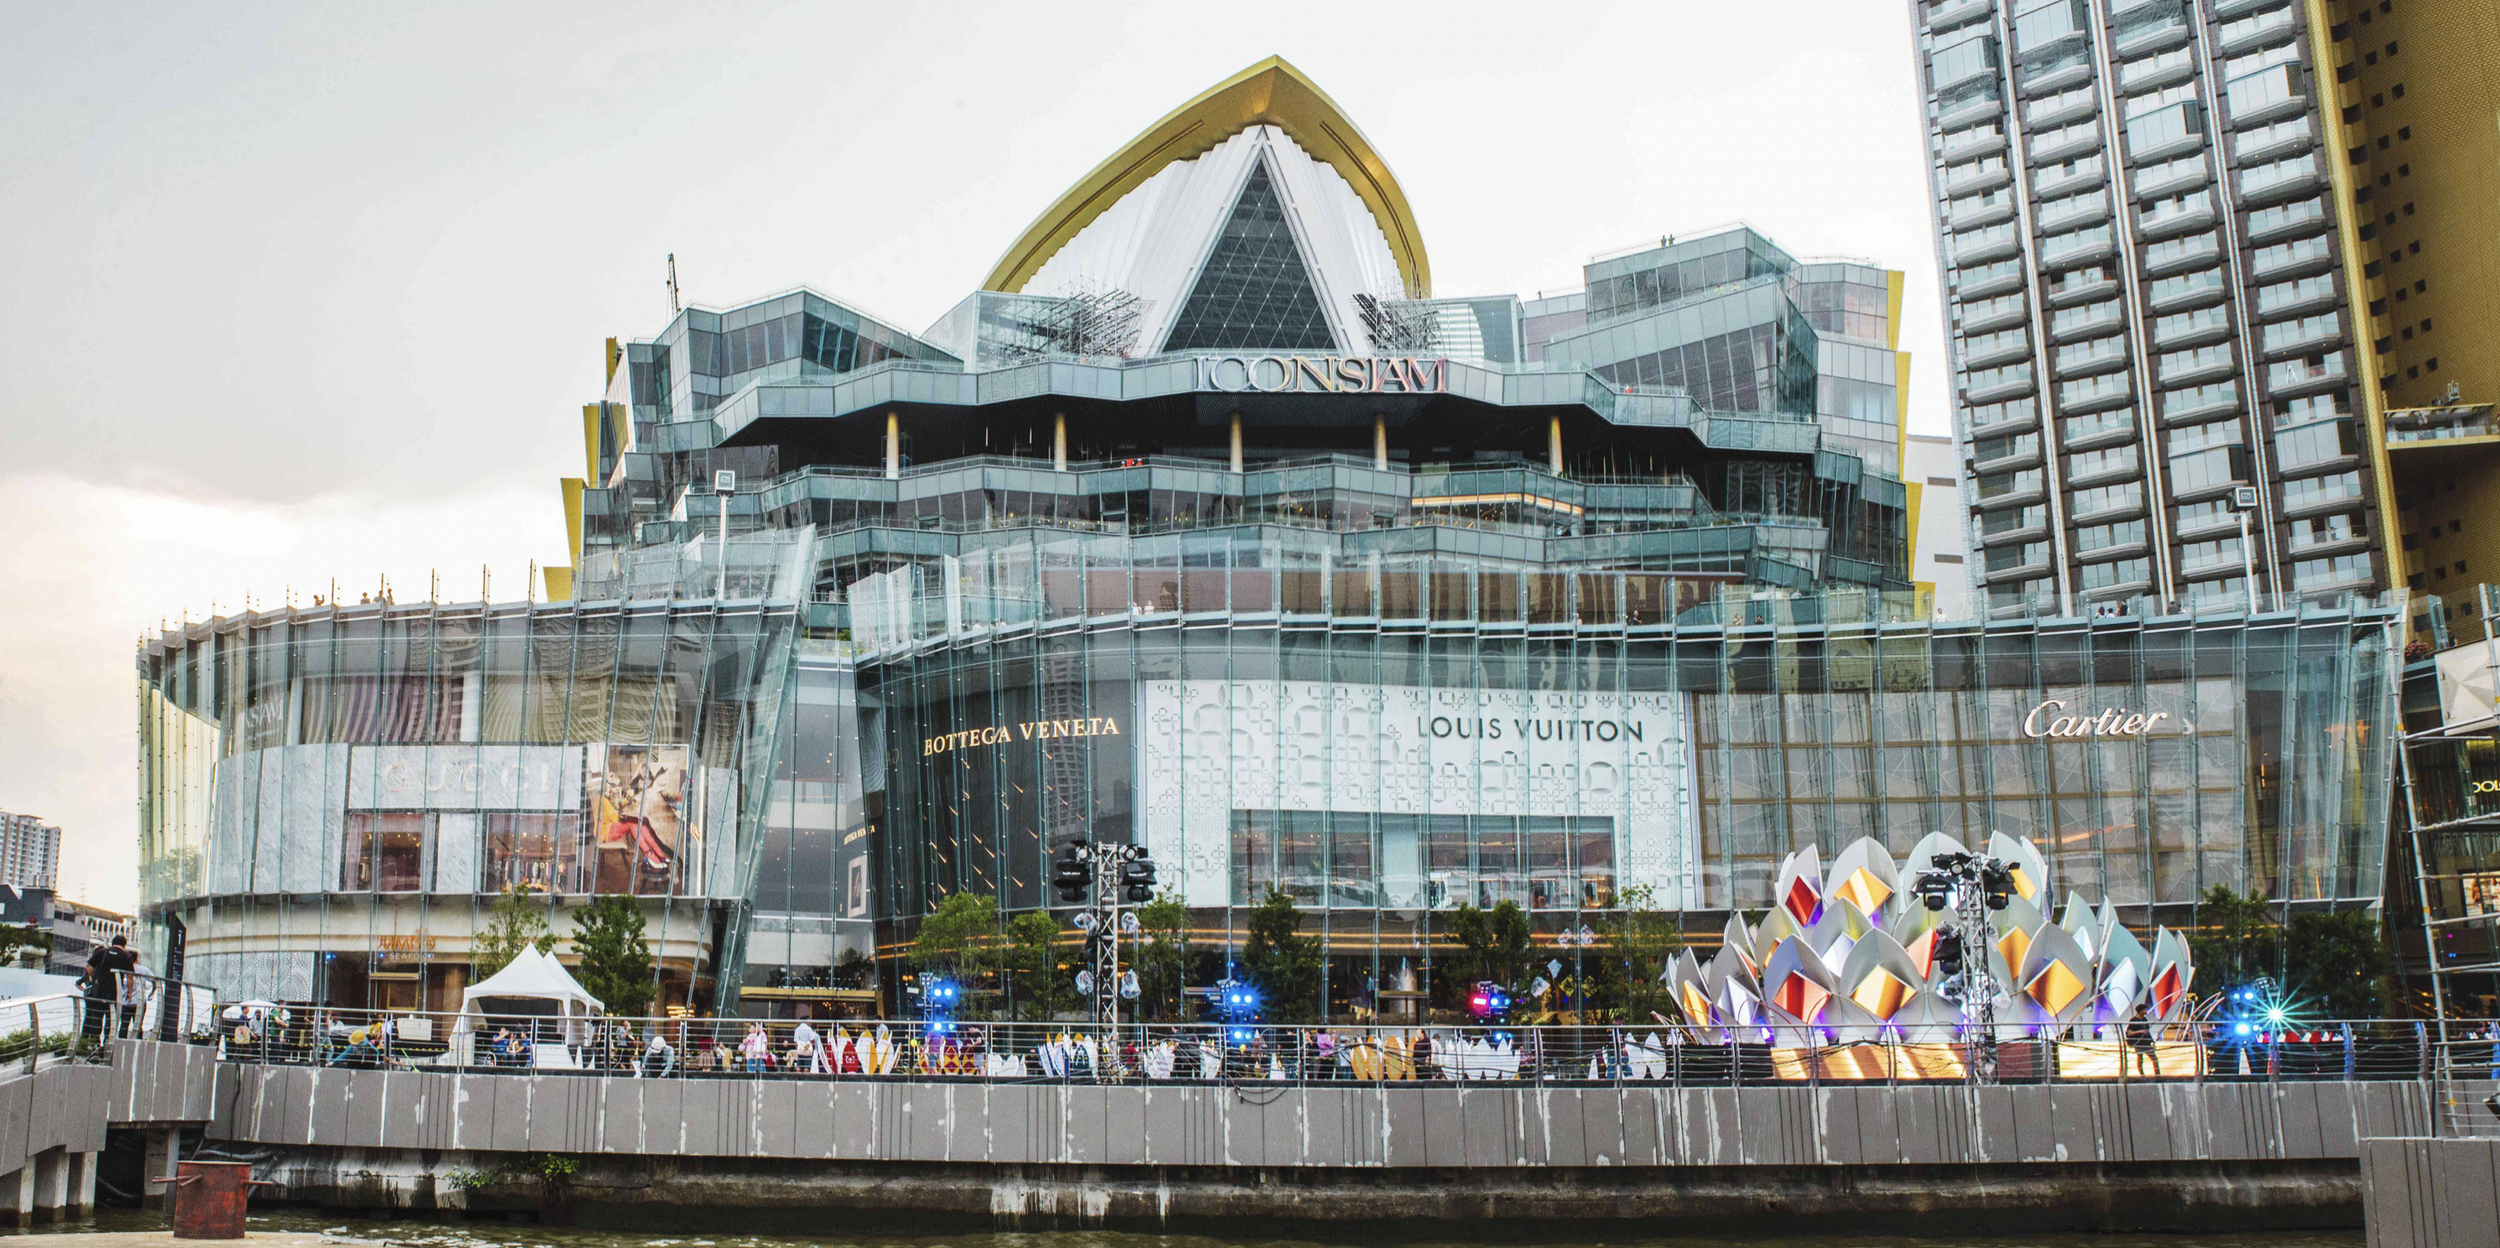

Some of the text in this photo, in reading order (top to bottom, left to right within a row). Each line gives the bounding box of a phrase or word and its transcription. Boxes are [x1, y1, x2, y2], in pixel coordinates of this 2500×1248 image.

[1194, 356, 1450, 392] ICONSIAM
[923, 717, 1120, 756] BOTTEGA VENETA
[1417, 716, 1643, 742] LOUIS VUITTON
[2024, 700, 2168, 737] Cartier
[390, 952, 435, 960] SEAFOD
